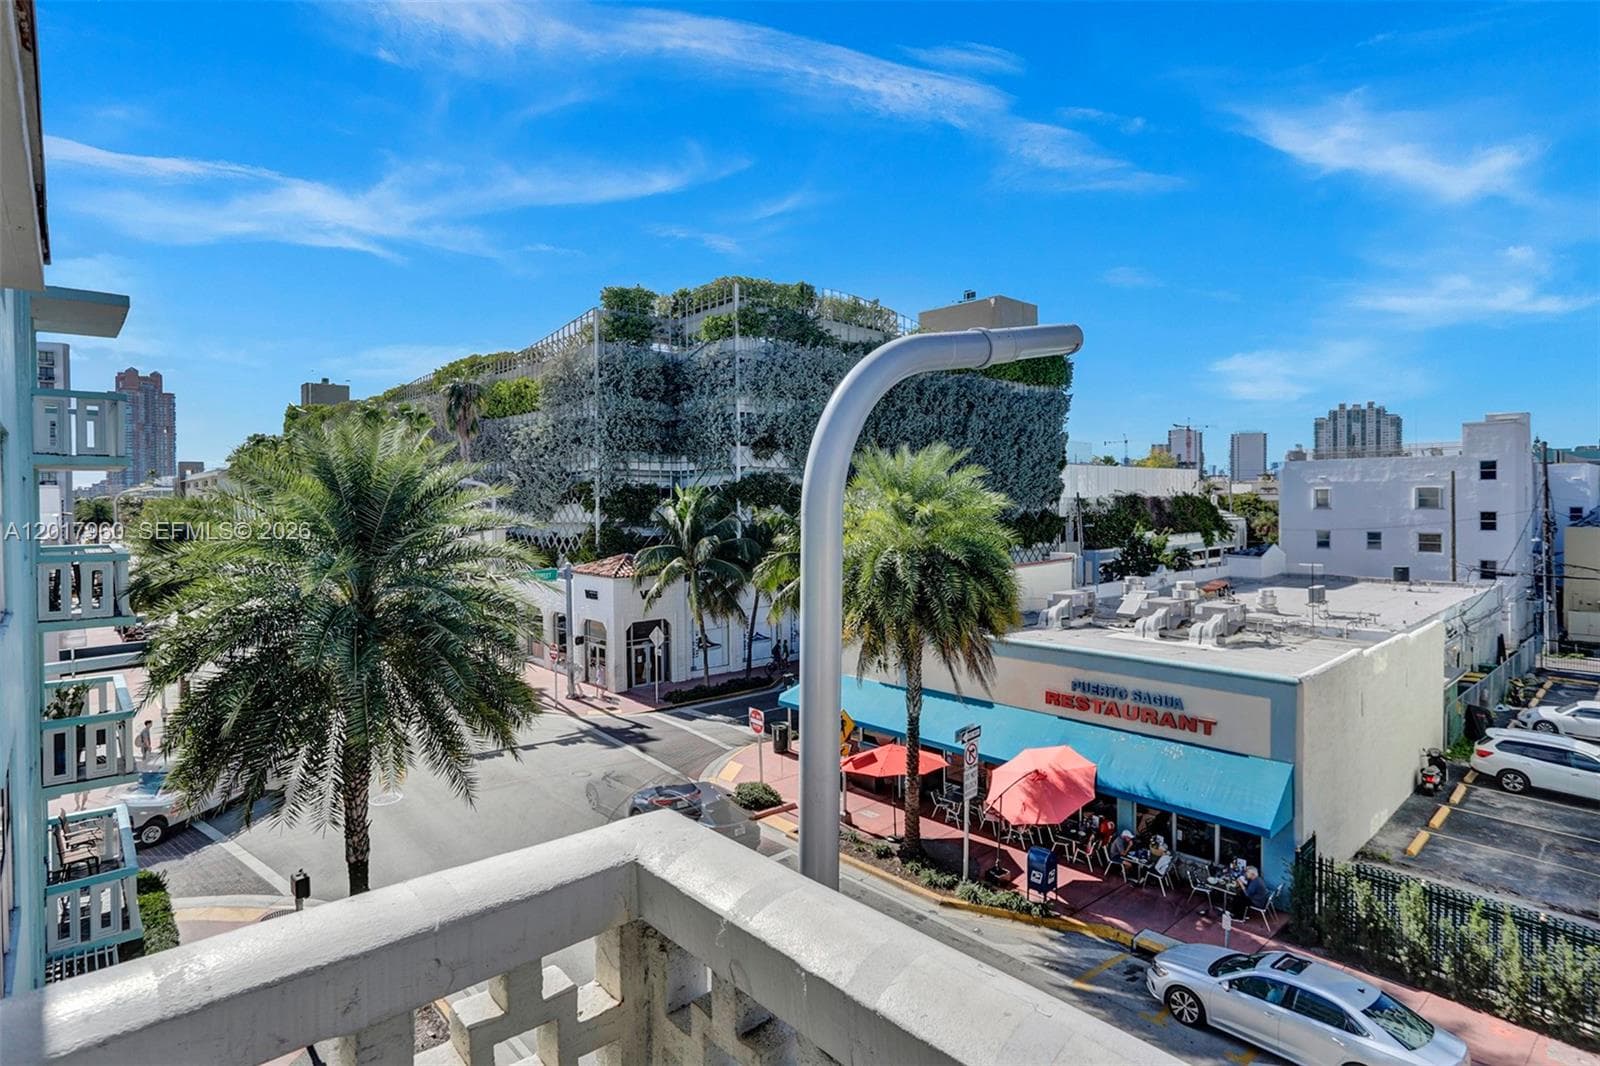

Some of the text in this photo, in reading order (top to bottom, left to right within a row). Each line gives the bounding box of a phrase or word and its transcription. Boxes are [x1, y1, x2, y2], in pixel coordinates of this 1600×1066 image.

[1045, 690, 1217, 735] RESTAURANT
[1071, 680, 1184, 710] PUERTO SAGUA
